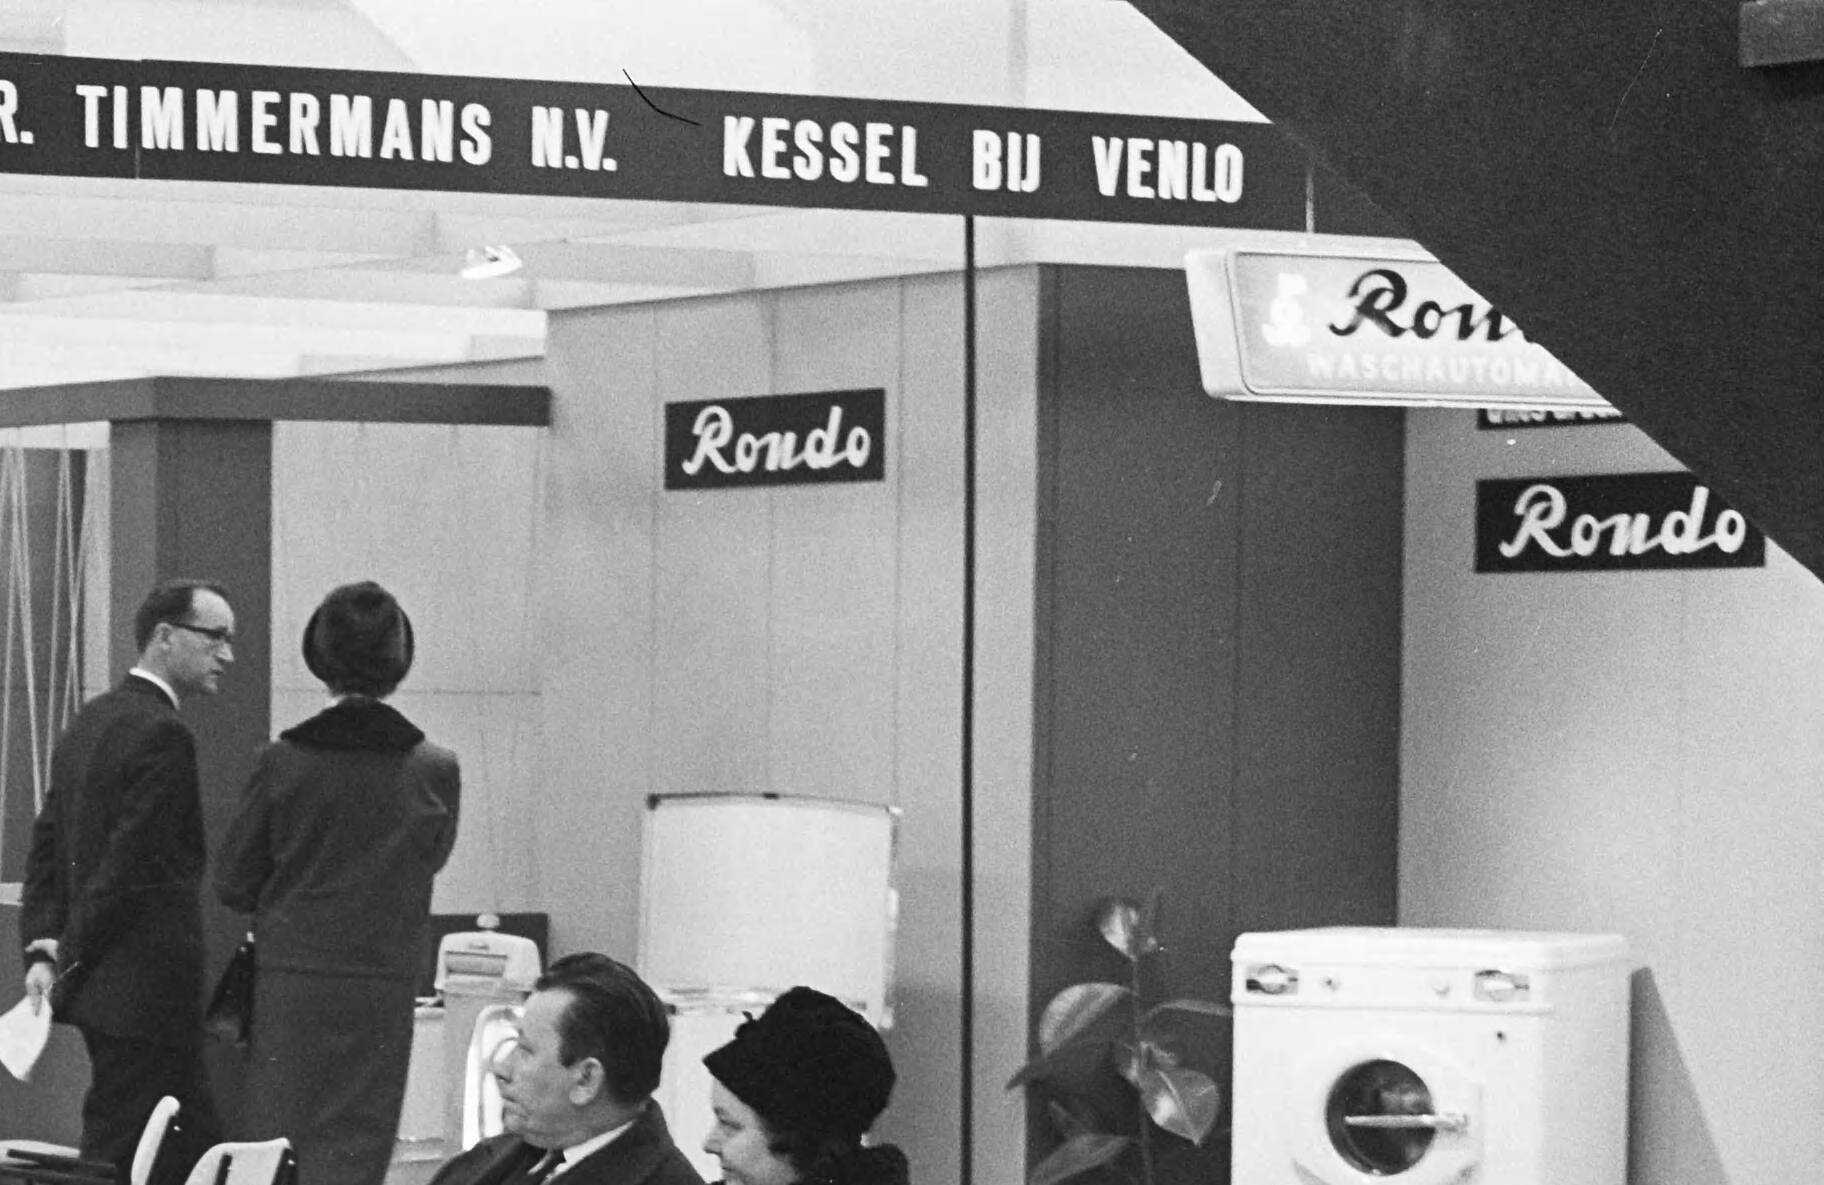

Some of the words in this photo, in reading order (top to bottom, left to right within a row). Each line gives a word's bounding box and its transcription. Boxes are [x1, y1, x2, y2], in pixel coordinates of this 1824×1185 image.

[76, 84, 492, 166] TIMMERMANS
[530, 105, 619, 172] N.V.
[723, 115, 928, 187] KESSEL
[972, 129, 1041, 192] BIJ
[1092, 136, 1244, 203] VENLO
[1328, 268, 1522, 343] Ron
[1306, 350, 1576, 388] WASCHAUTOMA
[681, 405, 872, 475] Rondo
[1497, 484, 1746, 558] Rondo
